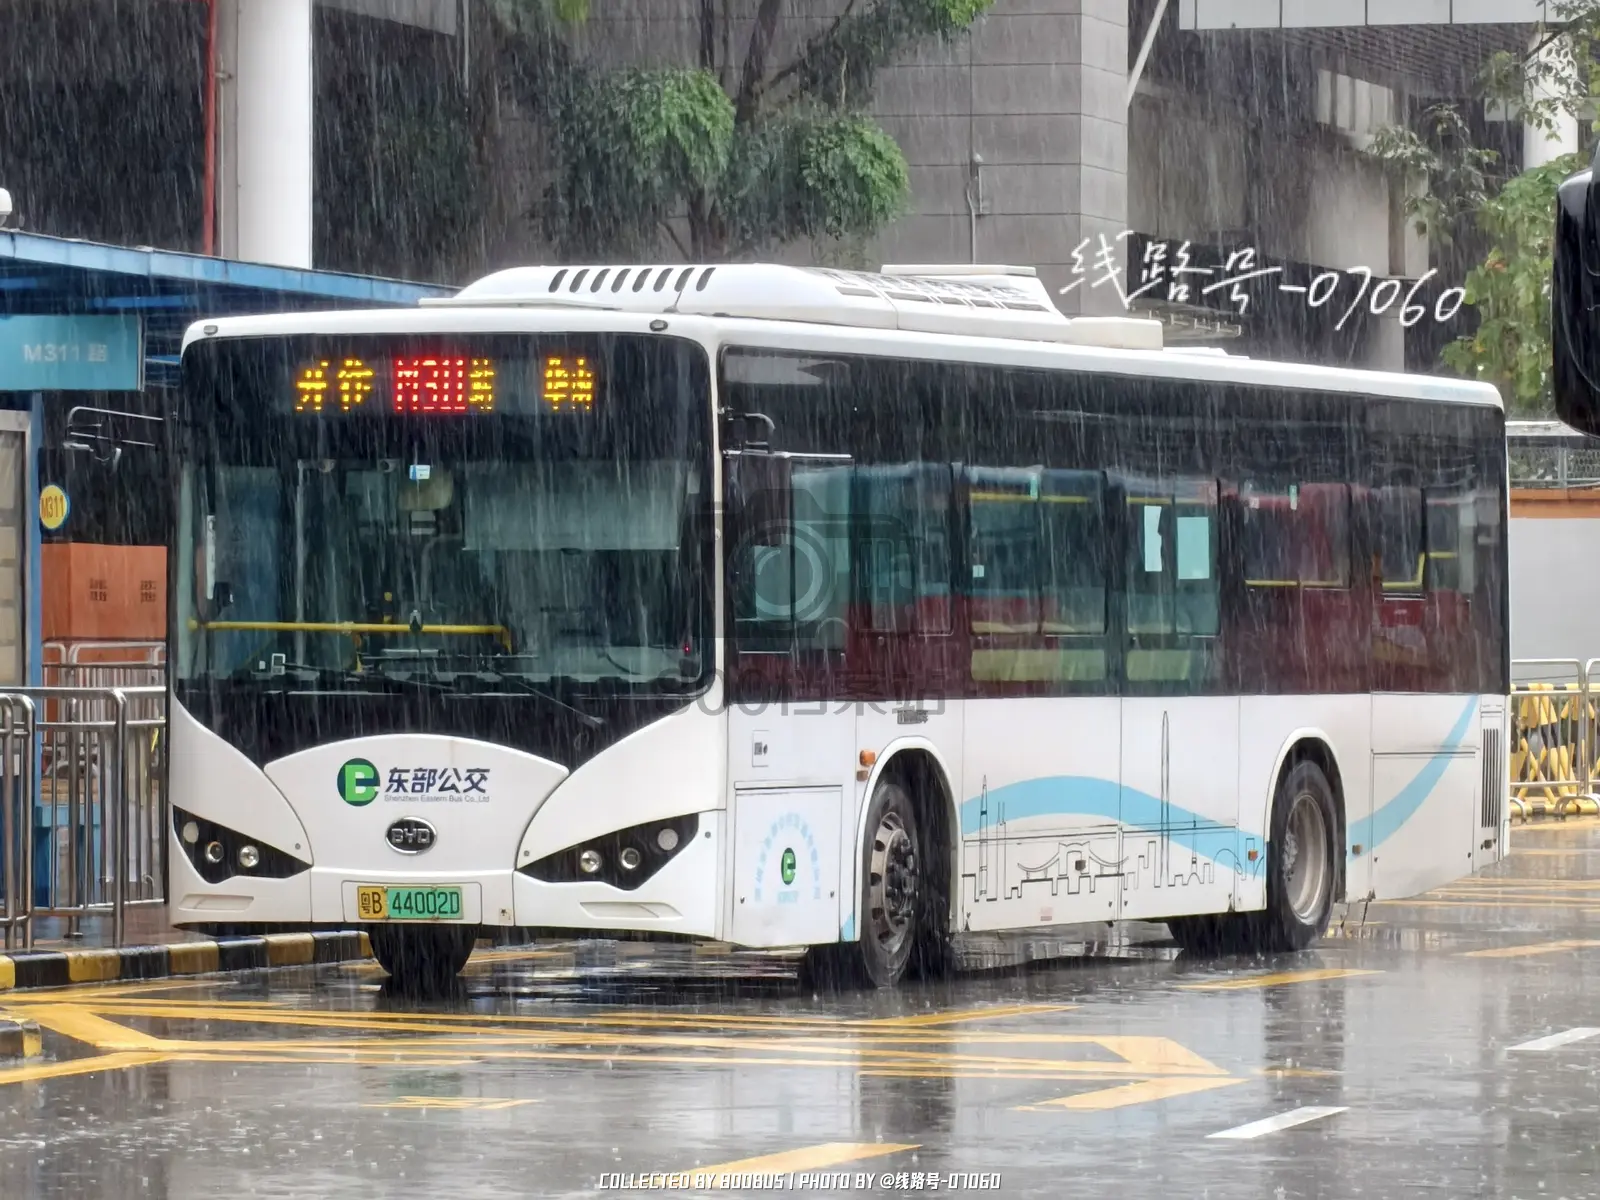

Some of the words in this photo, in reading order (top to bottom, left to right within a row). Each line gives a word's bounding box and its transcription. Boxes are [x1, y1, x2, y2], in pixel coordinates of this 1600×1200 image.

[23, 343, 80, 362] M311
[40, 496, 65, 518] M311
[385, 767, 491, 794] 东部公交
[384, 794, 419, 802] Shenzhen
[420, 794, 448, 802] Eastern
[449, 794, 463, 802] Bus
[391, 827, 431, 844] BYD
[392, 891, 460, 914] 44002D
